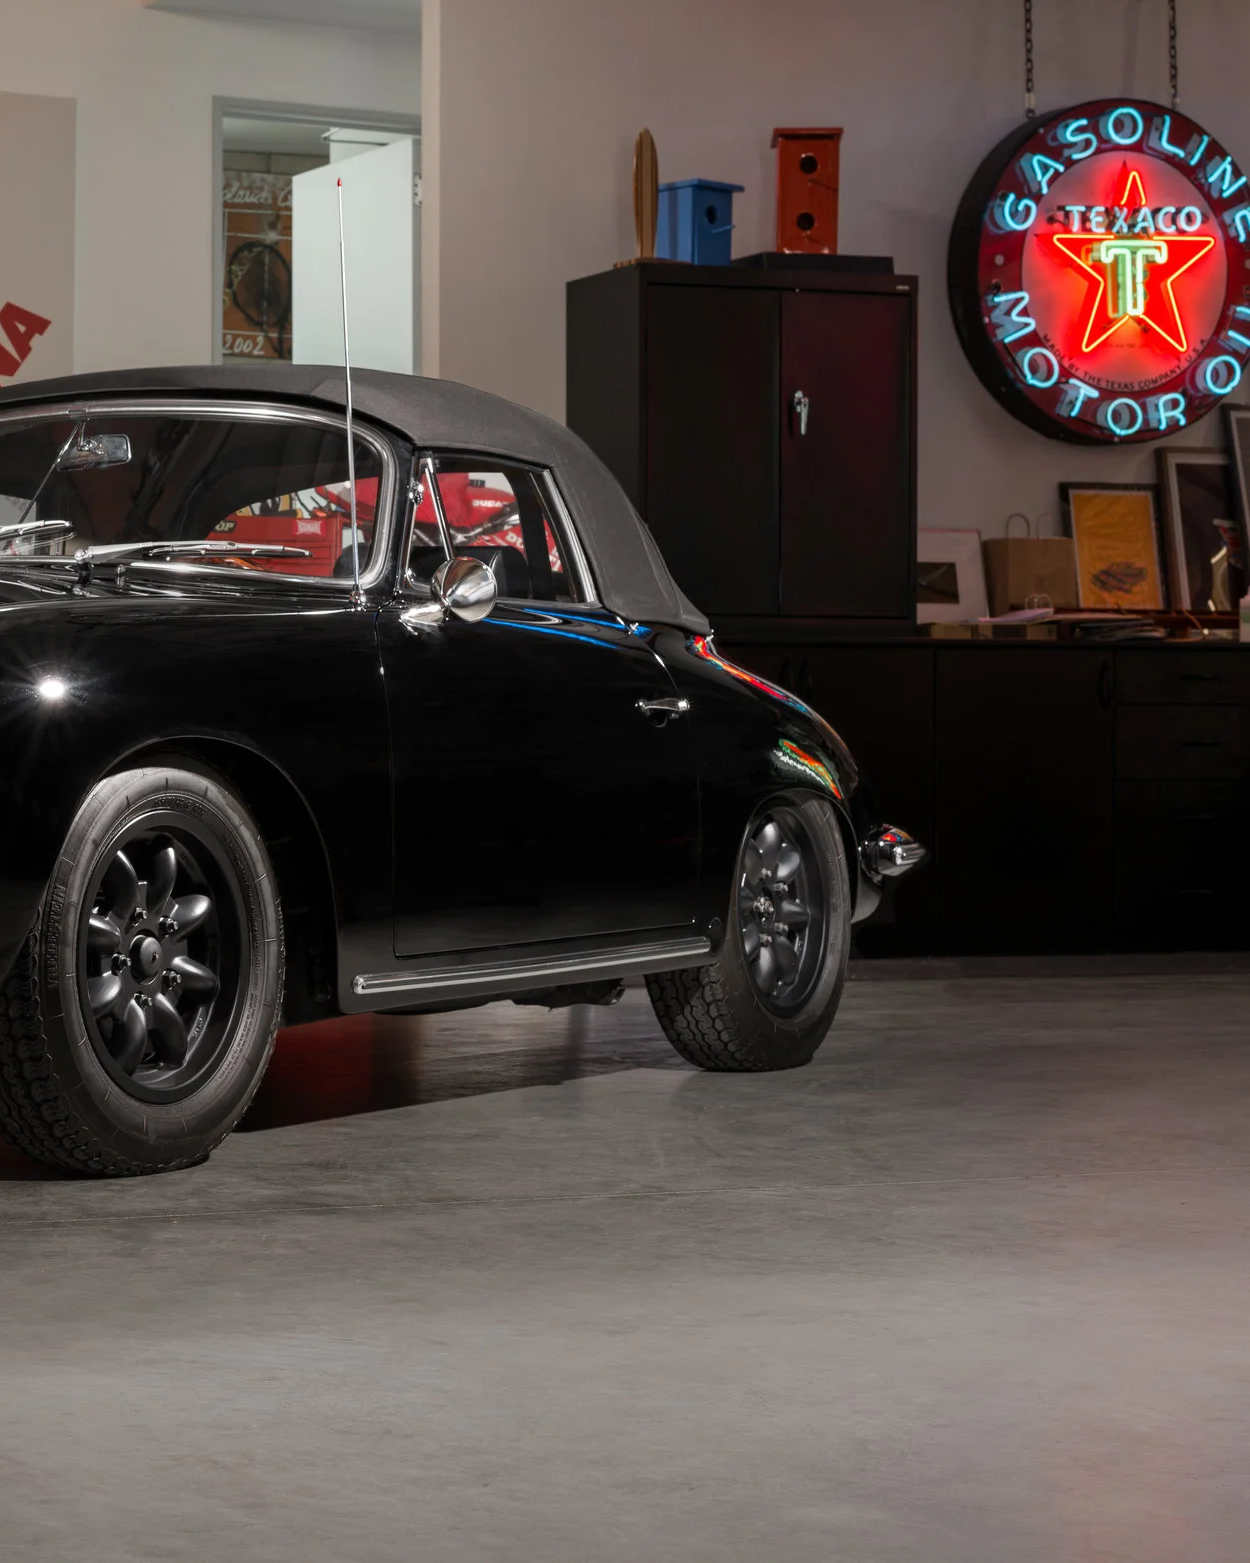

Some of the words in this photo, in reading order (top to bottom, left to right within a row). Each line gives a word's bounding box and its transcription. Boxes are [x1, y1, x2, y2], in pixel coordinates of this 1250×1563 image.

[1065, 205, 1202, 233] TEXACO
[222, 334, 265, 355] 2002
[993, 290, 1187, 437] MOTOR
[1042, 334, 1065, 362] MADE
[1068, 363, 1079, 374] BY
[1083, 372, 1102, 386] THE
[1105, 380, 1135, 390] TEXAS
[1138, 363, 1183, 389] COMPANY
